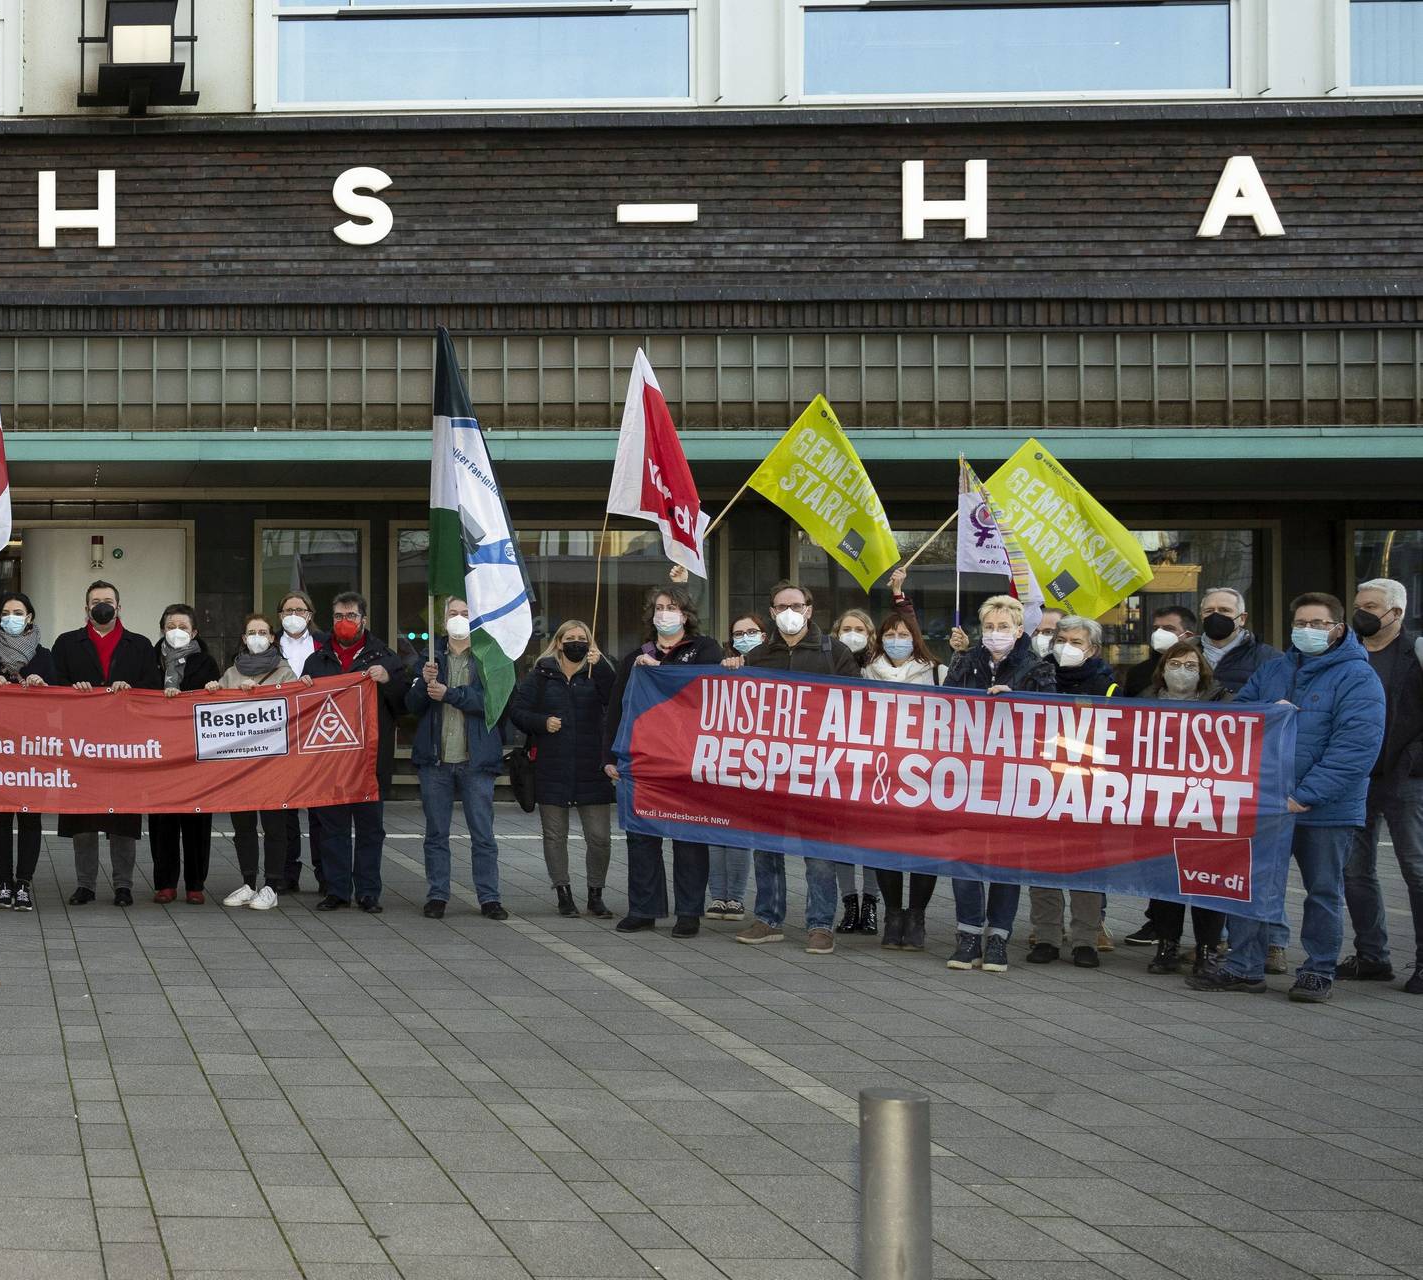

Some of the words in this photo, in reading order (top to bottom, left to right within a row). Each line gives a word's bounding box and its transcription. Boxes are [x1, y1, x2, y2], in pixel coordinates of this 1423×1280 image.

[779, 463, 857, 532] STARK
[842, 540, 859, 558] ver.di
[978, 558, 999, 567] Mehr
[1050, 580, 1066, 600] ver.di
[200, 706, 283, 728] Respekt!
[700, 678, 812, 740] UNSERE
[817, 687, 1123, 766] ALTERNATIVE
[1131, 710, 1259, 776] HEISST
[201, 731, 217, 740] Kein
[218, 730, 236, 739] Platz
[236, 729, 247, 738] für
[248, 726, 282, 736] Rassismus
[21, 735, 64, 757] hilft
[69, 737, 163, 760] Vernunft
[216, 745, 269, 756] www.respekt.tv
[690, 734, 873, 801] RESPEKT
[893, 753, 1254, 835] SOLIDARITÄT
[635, 808, 657, 817] ver.di
[659, 811, 709, 823] Landesbezirk
[710, 816, 730, 826] NRW
[1182, 867, 1245, 892] ver.di
